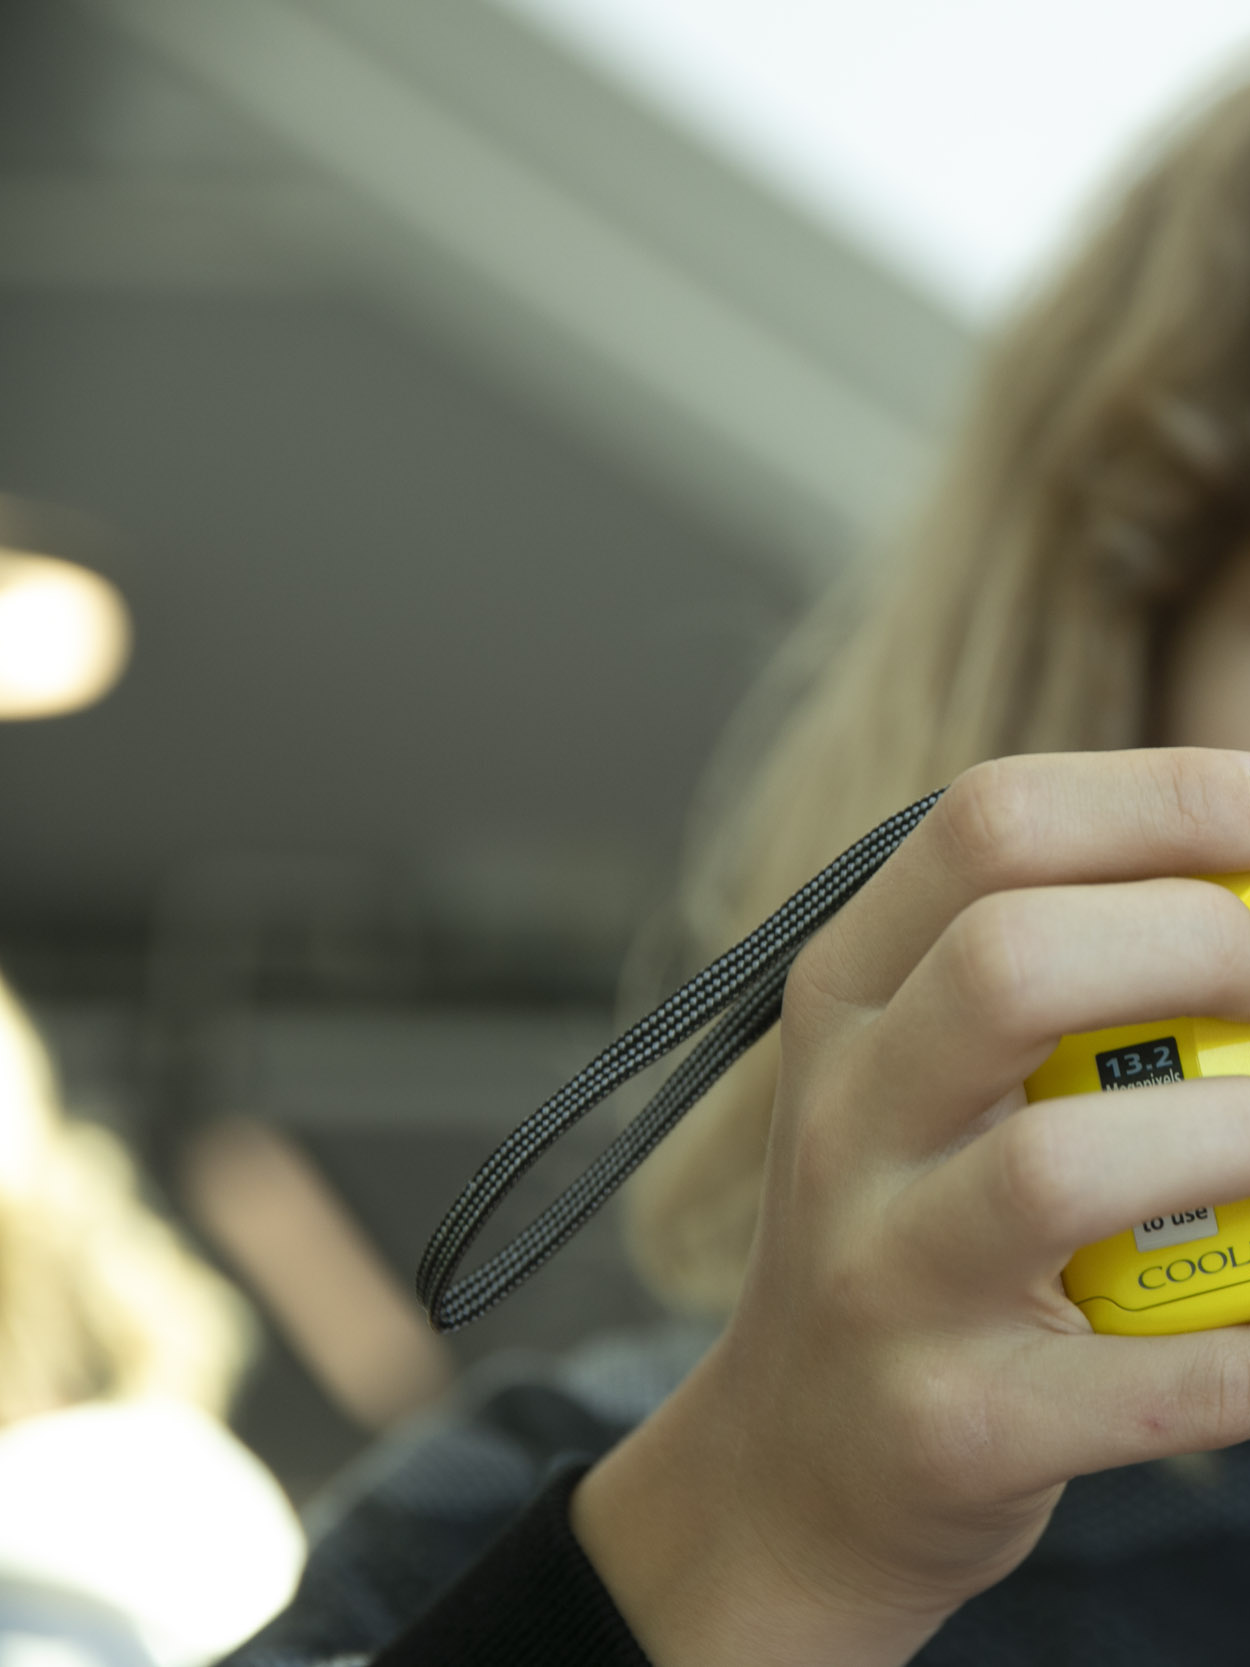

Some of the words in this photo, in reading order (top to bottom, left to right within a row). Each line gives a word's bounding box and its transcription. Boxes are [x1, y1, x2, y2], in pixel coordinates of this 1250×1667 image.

[1105, 1046, 1173, 1078] 13.2
[1143, 1216, 1164, 1232] to
[1171, 1207, 1208, 1226] use
